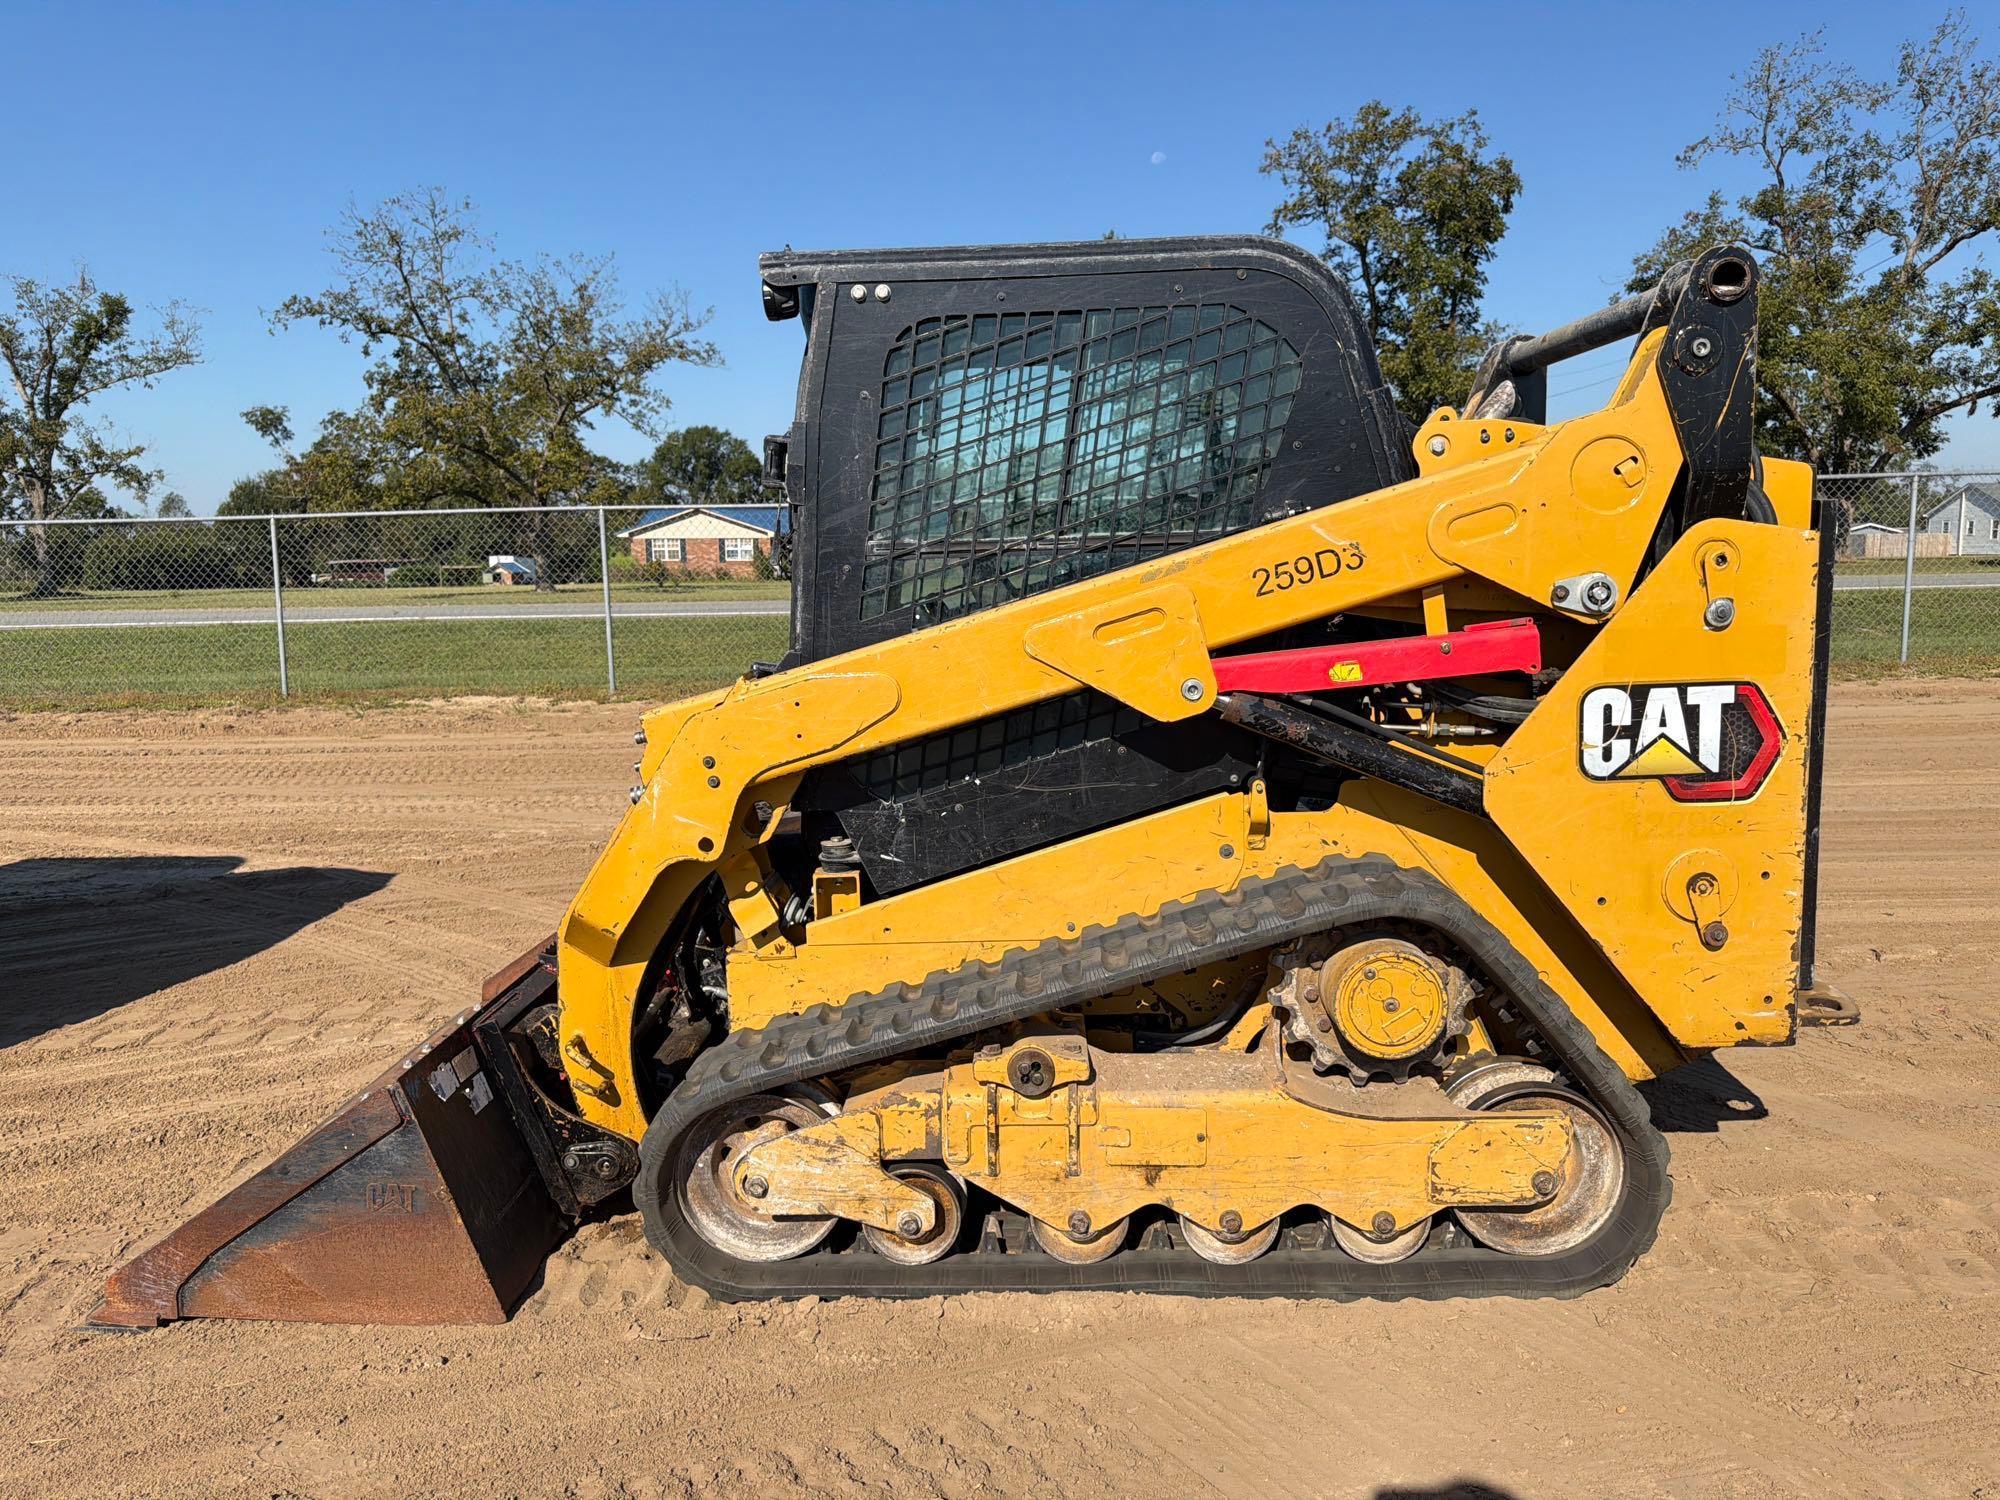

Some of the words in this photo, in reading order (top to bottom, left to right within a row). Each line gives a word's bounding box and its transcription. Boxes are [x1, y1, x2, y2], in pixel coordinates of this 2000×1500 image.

[1252, 543, 1366, 597] 259D3
[1583, 685, 1735, 777] CAT
[366, 1183, 416, 1213] CAT
